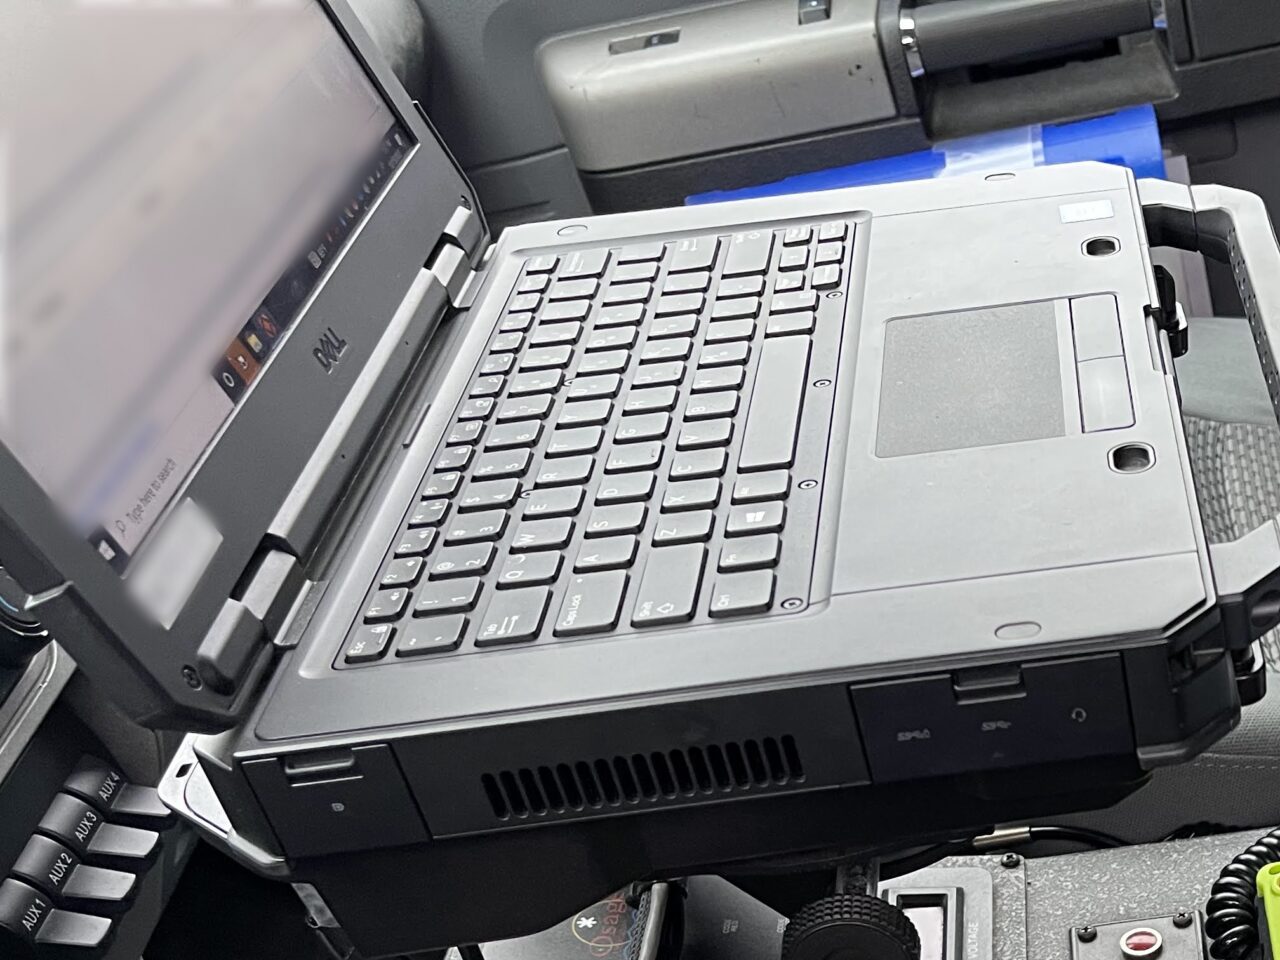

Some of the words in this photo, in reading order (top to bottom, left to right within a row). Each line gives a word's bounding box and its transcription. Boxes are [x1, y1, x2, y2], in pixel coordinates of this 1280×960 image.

[312, 327, 347, 374] DELL
[593, 520, 609, 528] S
[660, 528, 677, 536] Z
[519, 533, 536, 544] W
[583, 554, 600, 562] A
[505, 570, 523, 579] Q
[563, 611, 576, 626] Caps
[573, 594, 582, 611] Lock
[484, 624, 497, 636] Tab
[350, 641, 365, 654] Esc
[99, 777, 115, 801] AUX
[110, 771, 120, 781] 4
[75, 818, 92, 842] AUX
[86, 811, 97, 821] 3
[48, 860, 67, 885] AUX
[62, 852, 73, 864] 2
[22, 905, 42, 931] AUX
[35, 898, 46, 907] 1
[967, 921, 979, 959] VOLTAGE
